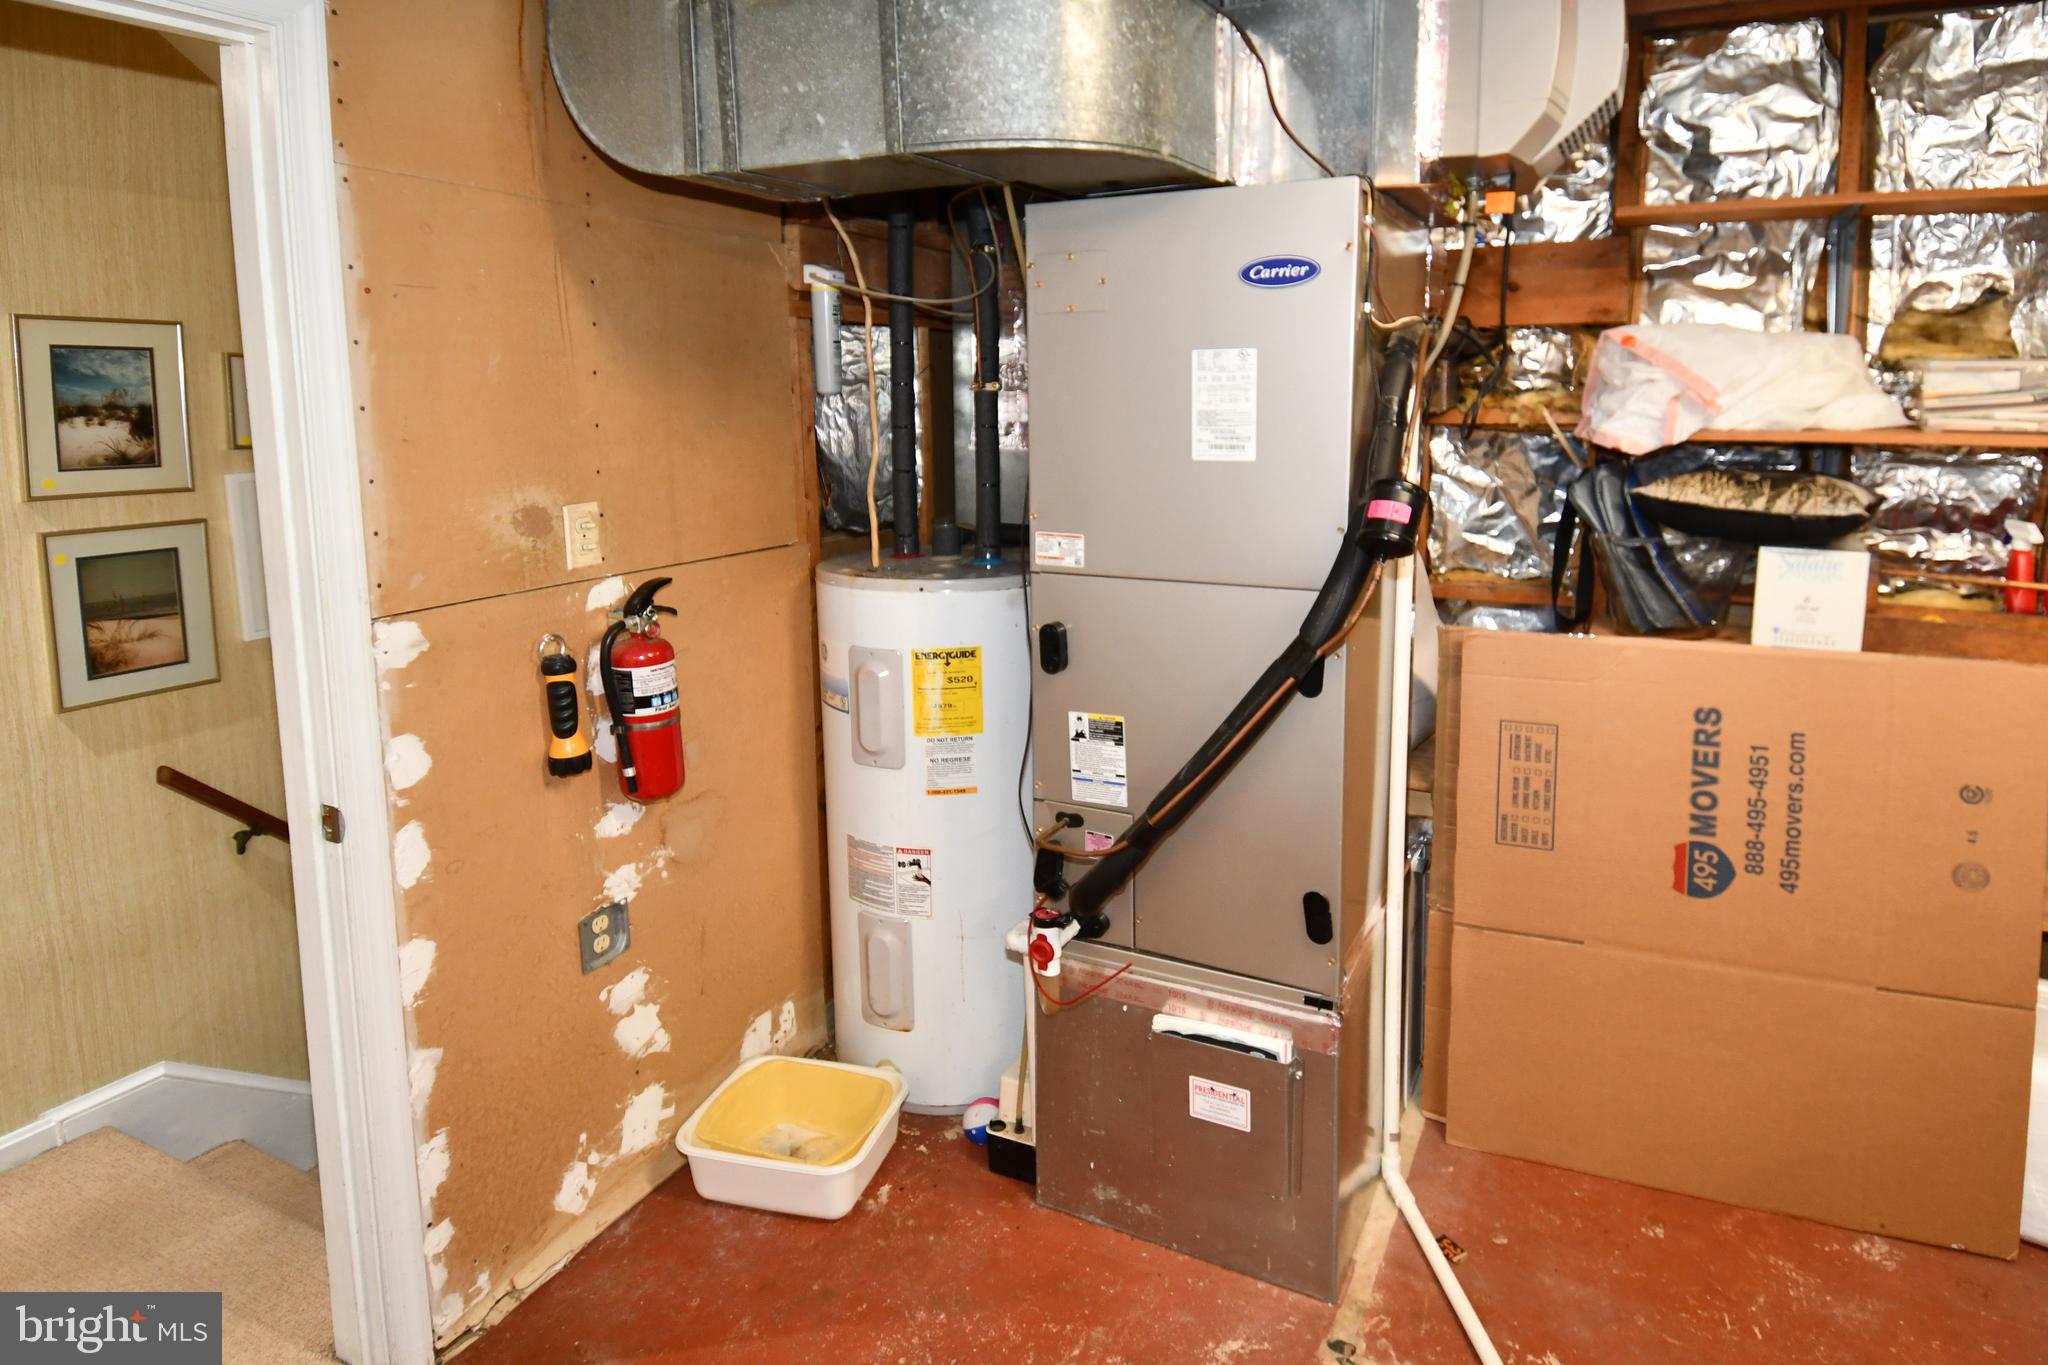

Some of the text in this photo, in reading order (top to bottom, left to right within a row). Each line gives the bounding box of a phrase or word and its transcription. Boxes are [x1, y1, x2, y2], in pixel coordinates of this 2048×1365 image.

[1249, 264, 1310, 279] Carrier
[946, 675, 973, 684] $520
[1688, 707, 1723, 837] MOVERS
[1744, 745, 1770, 876] 888-495-4951
[1779, 732, 1806, 894] 495movers.com
[1692, 850, 1720, 892] 495
[1195, 1084, 1245, 1104] PRESIDENTIAL
